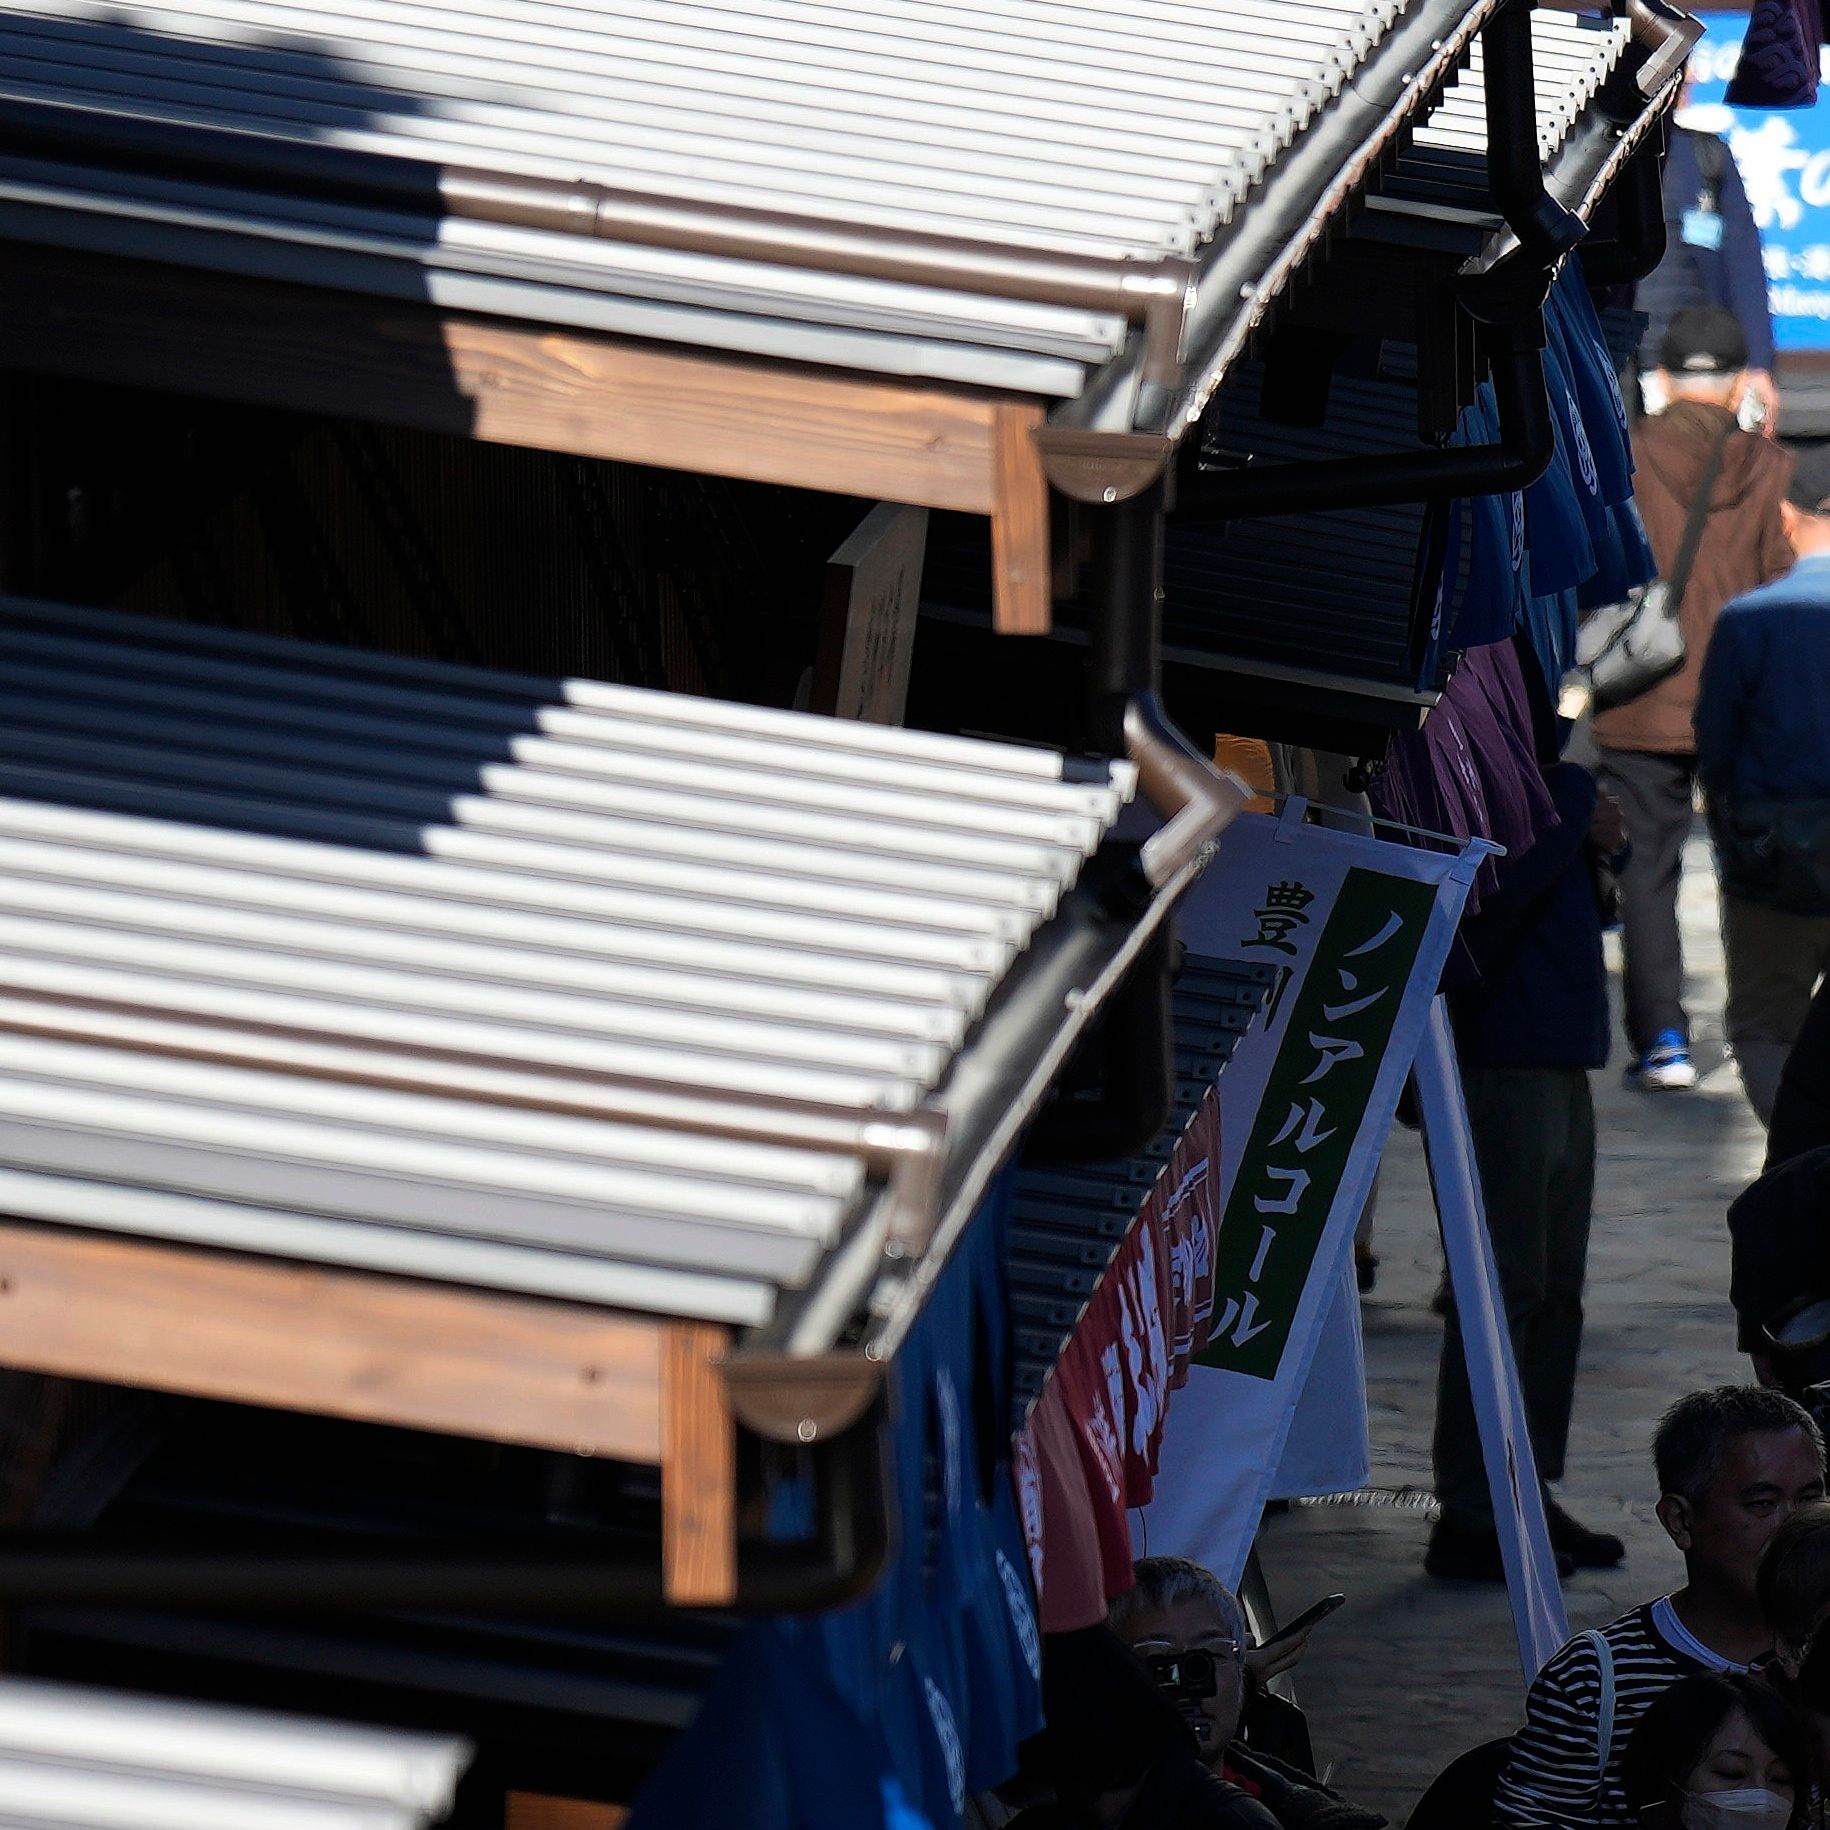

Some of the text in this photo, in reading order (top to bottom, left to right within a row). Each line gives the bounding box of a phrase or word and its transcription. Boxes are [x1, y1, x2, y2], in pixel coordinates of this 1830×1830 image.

[1209, 908, 1405, 1349] ノンアルコール
